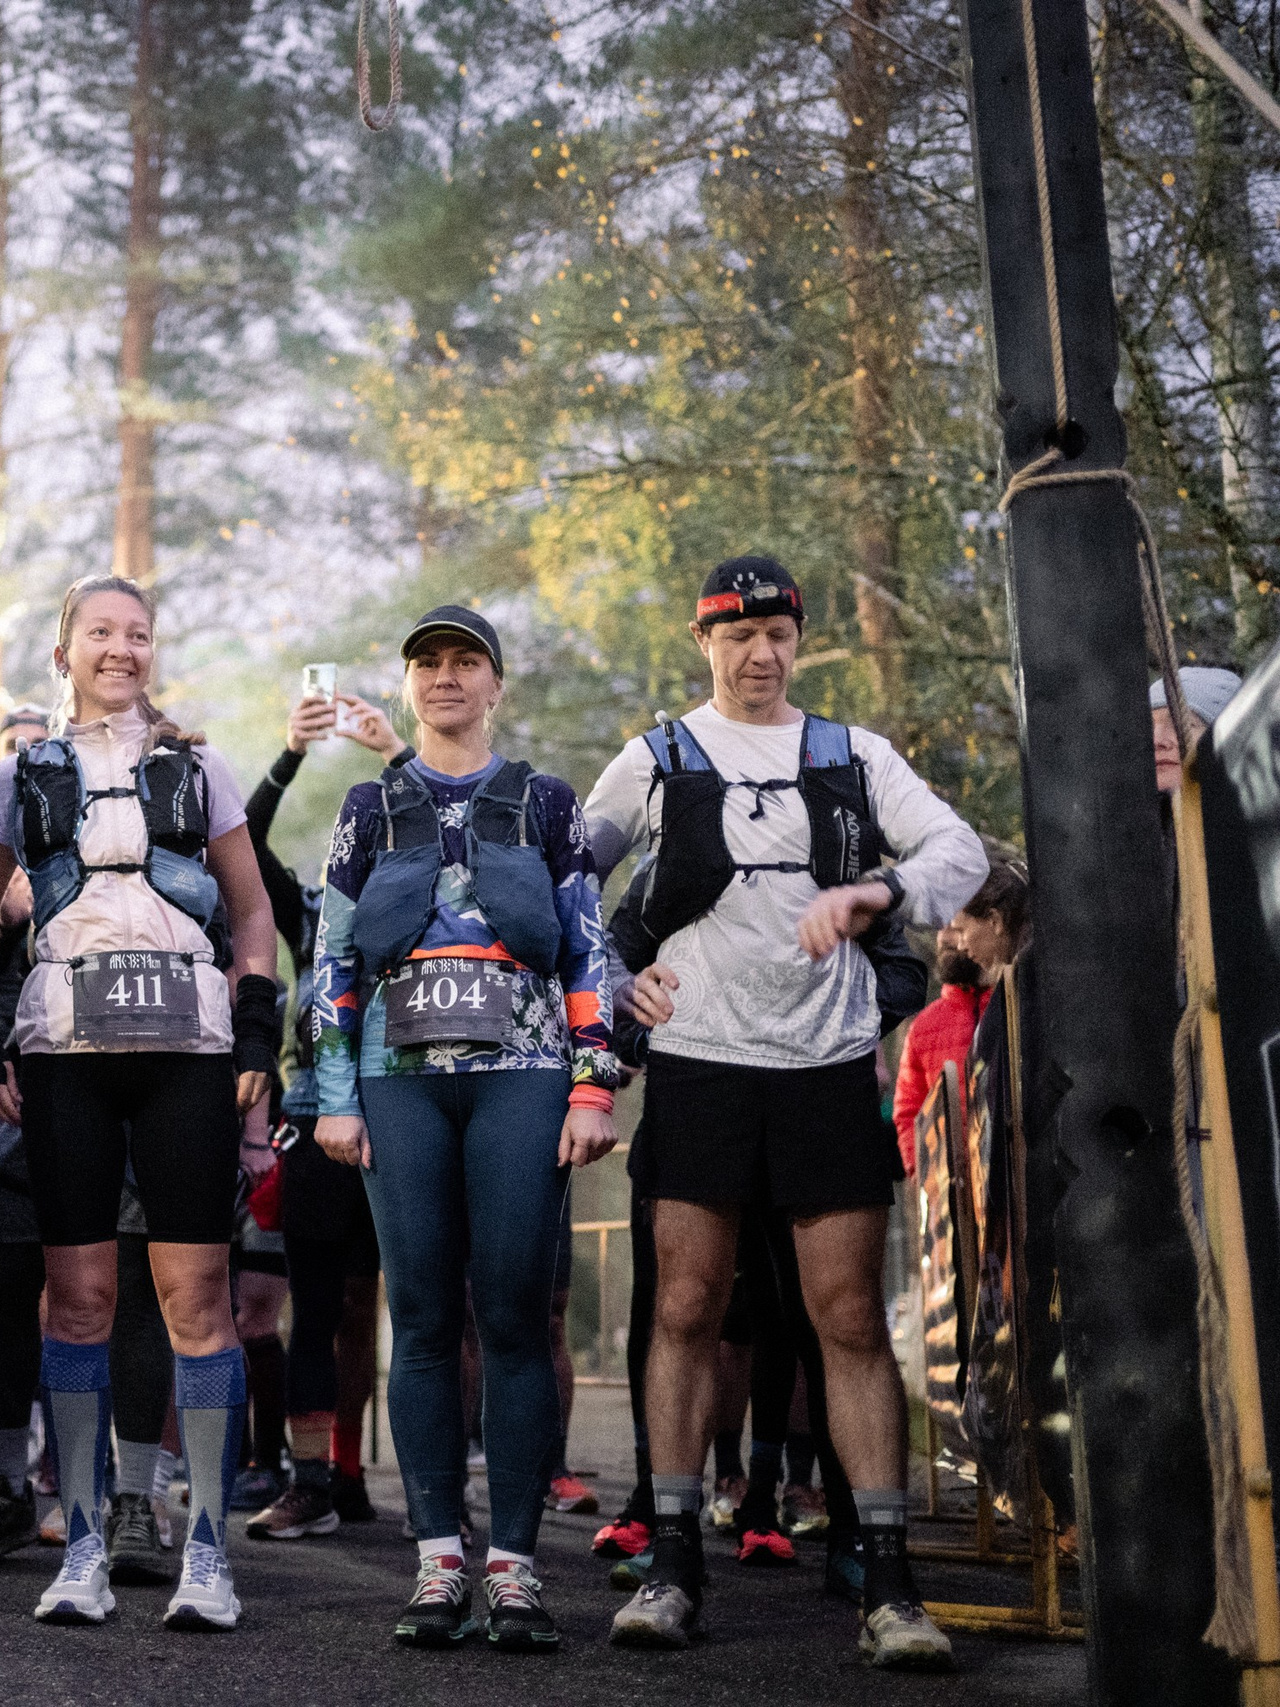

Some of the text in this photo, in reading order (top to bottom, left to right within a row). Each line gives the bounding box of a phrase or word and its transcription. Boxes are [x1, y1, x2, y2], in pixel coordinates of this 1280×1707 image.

[845, 808, 861, 880] AONIJIE
[106, 974, 166, 1008] 411
[406, 977, 487, 1013] 404
